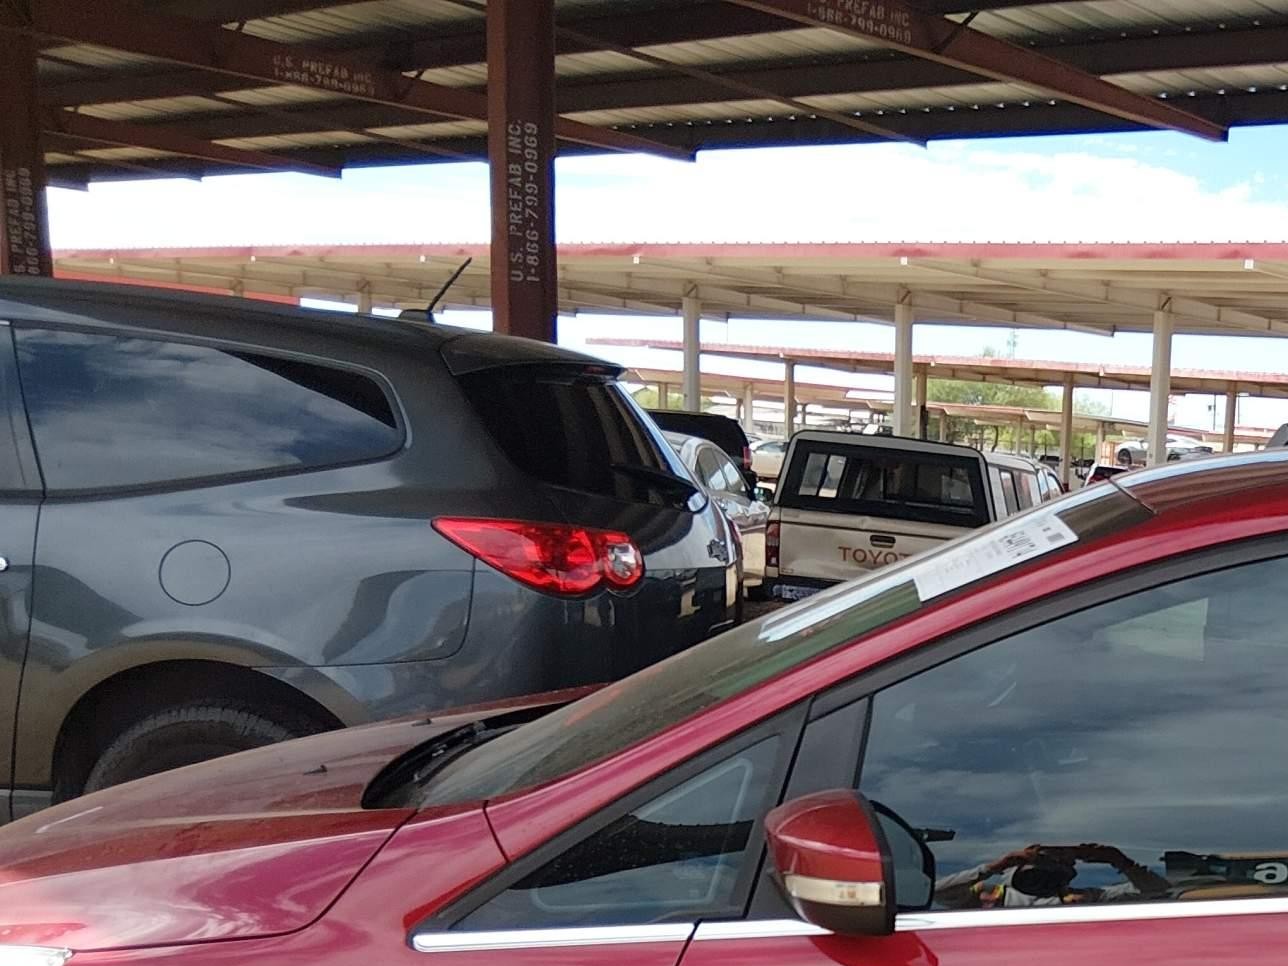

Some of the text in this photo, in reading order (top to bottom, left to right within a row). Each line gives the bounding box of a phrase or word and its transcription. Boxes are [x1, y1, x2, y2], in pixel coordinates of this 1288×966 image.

[508, 163, 523, 237] PREFAB
[524, 121, 541, 282] 1-866-799-0969
[837, 545, 913, 565] TOYO
